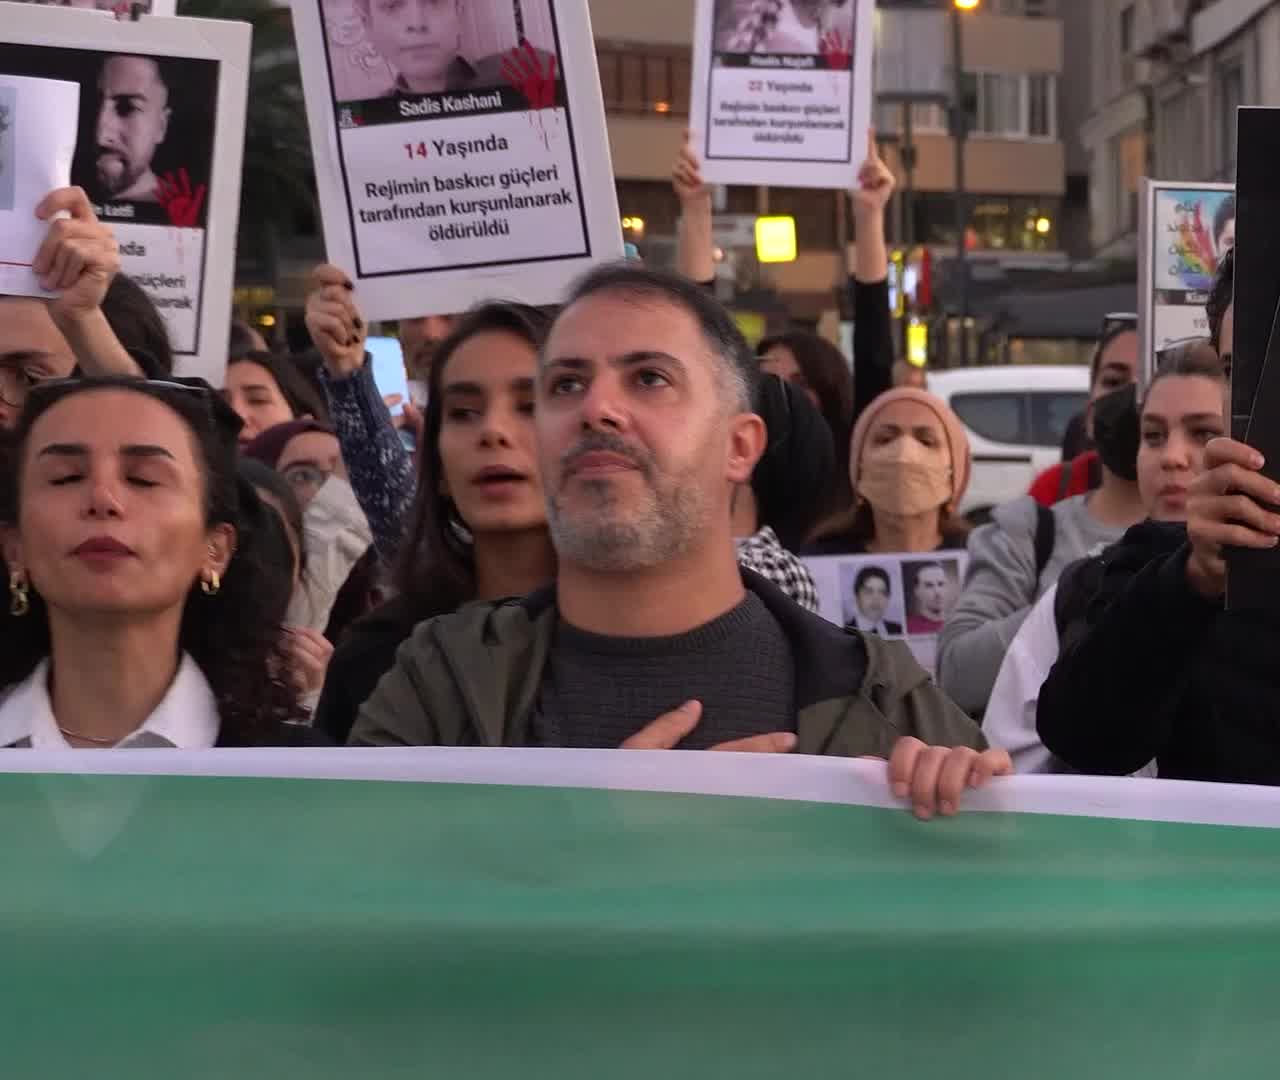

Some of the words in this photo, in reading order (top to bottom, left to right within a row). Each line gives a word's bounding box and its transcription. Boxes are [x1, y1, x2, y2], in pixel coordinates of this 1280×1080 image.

[399, 99, 441, 117] Sadis
[444, 92, 502, 114] Kashani
[404, 141, 428, 160] 14
[432, 134, 509, 159] Yaşında
[365, 176, 431, 201] Rejimin
[435, 173, 496, 193] baskıcı
[500, 164, 559, 189] güçleri
[359, 199, 447, 224] tarafından
[450, 188, 573, 216] kurşunlanarak
[428, 219, 510, 242] öldürüldü
